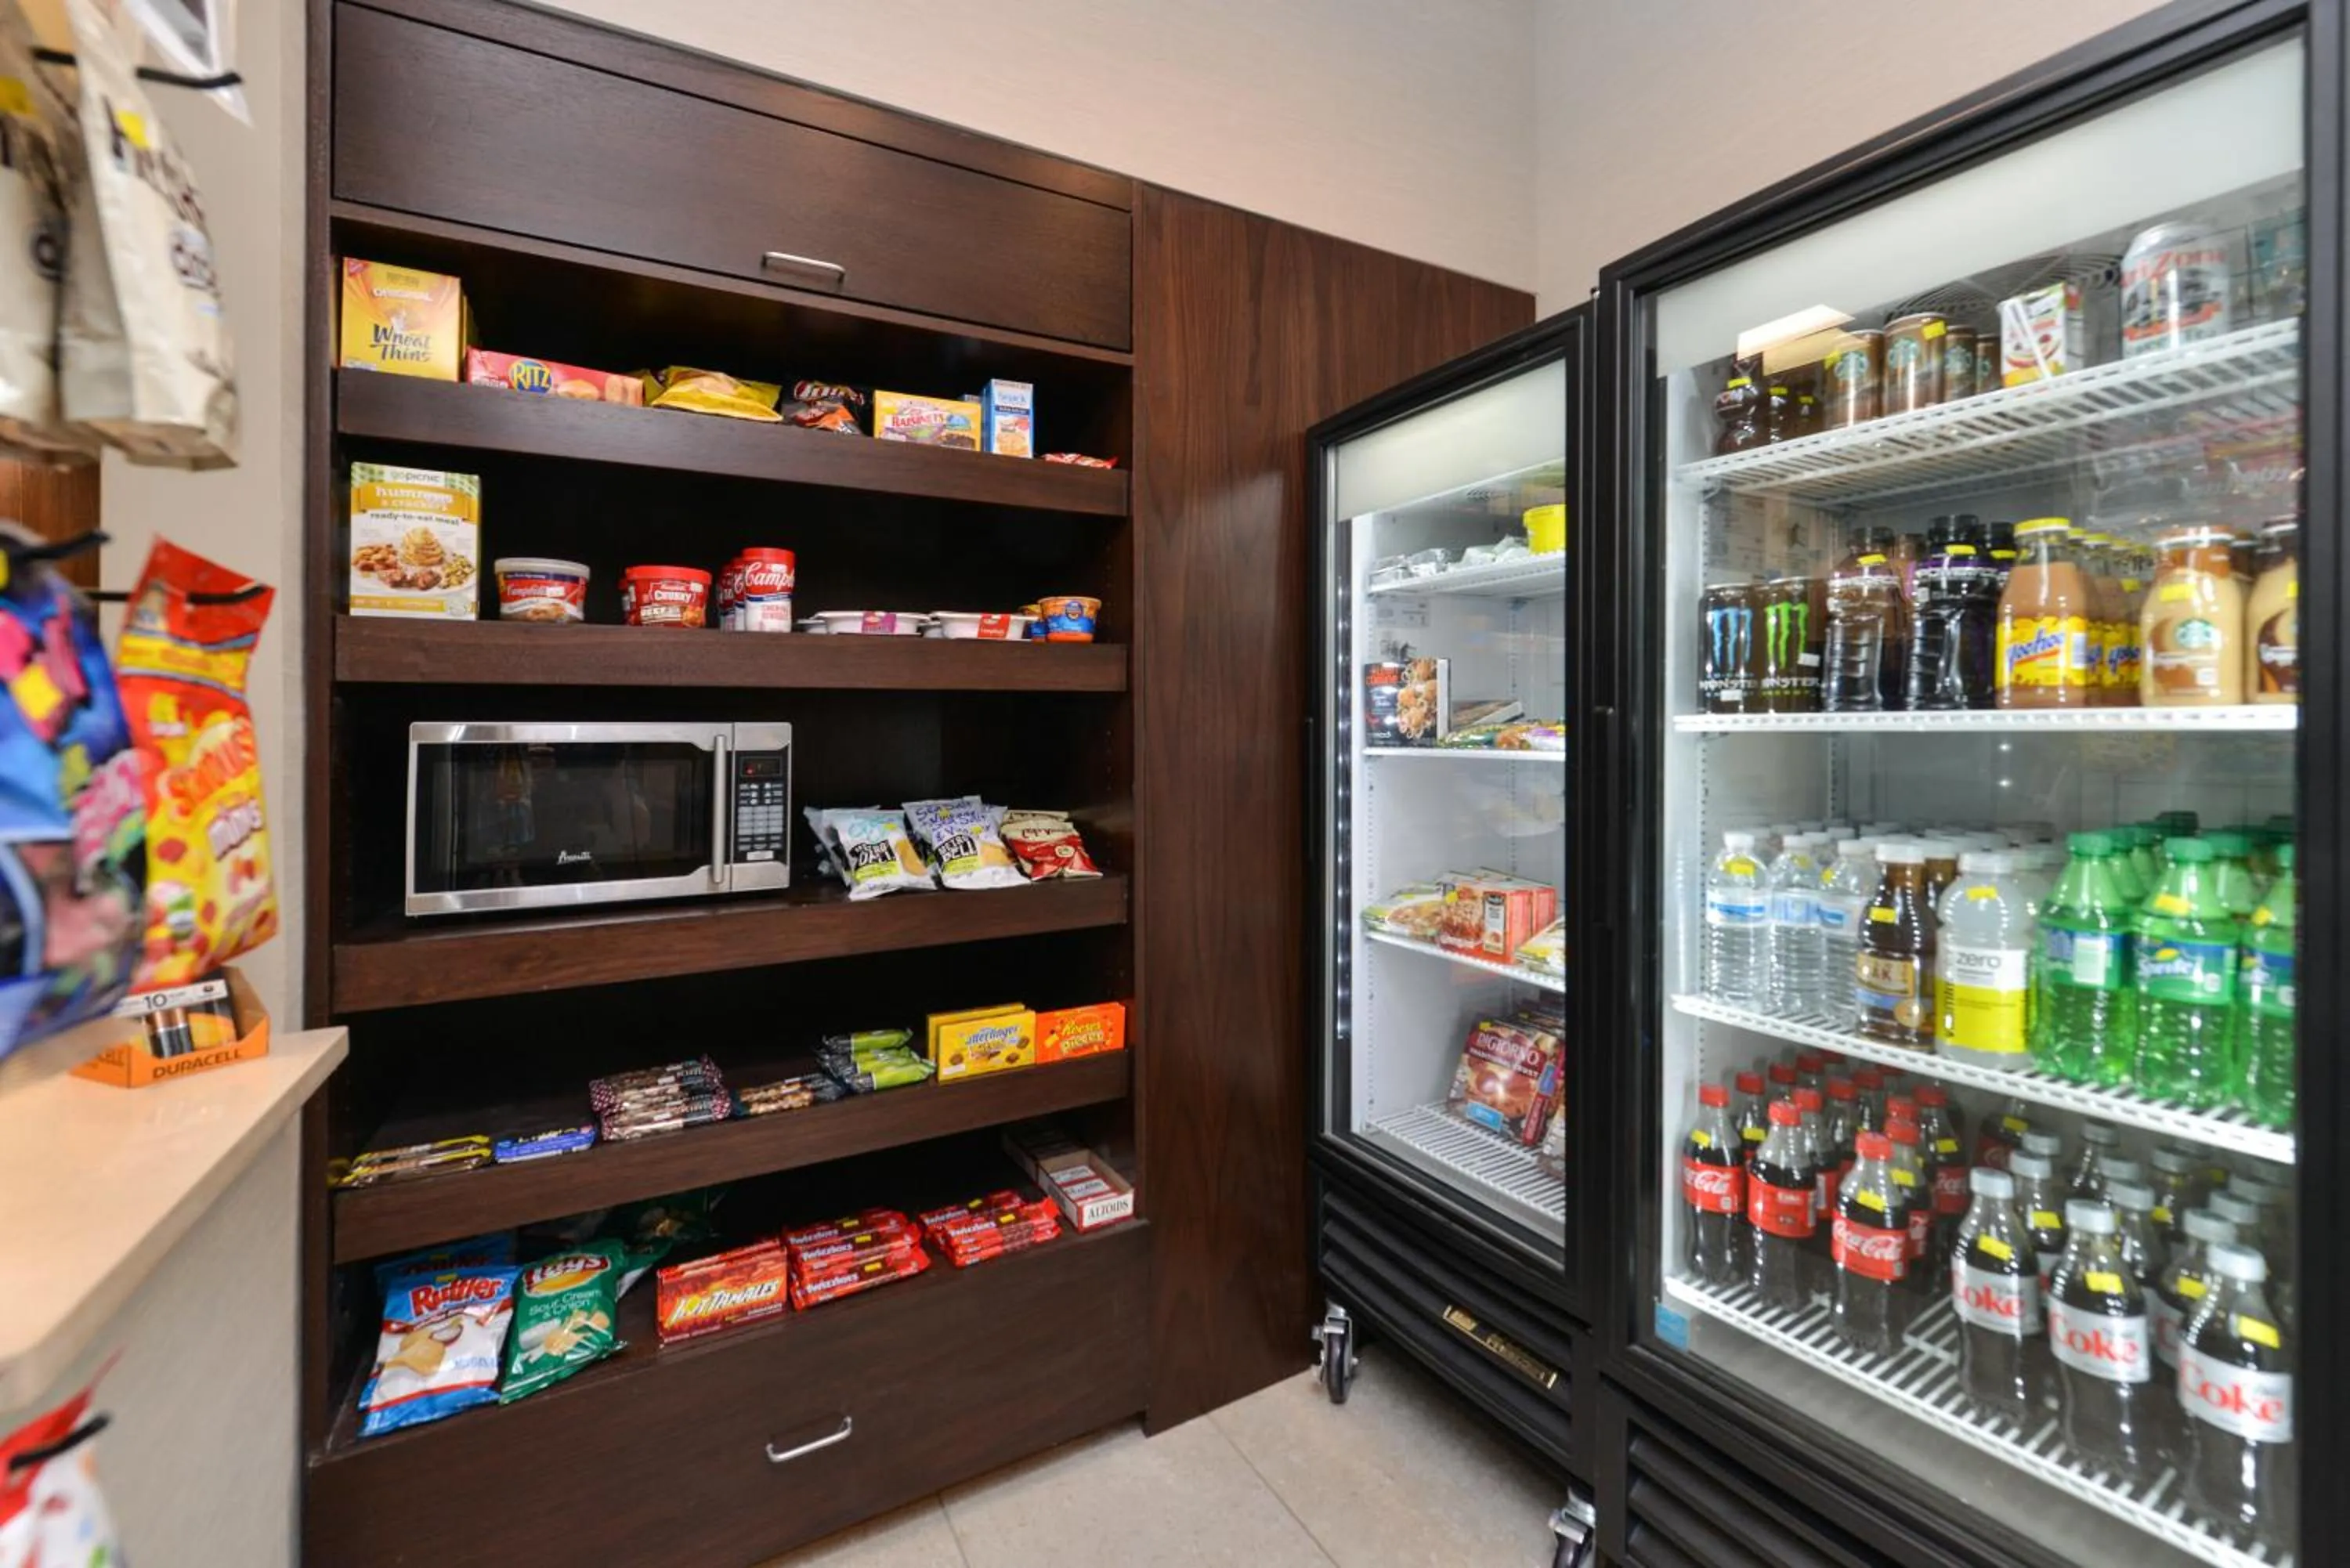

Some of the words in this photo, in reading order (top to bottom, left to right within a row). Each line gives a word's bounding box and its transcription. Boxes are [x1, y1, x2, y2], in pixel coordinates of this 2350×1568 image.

[372, 323, 432, 349] Wheat
[369, 343, 432, 363] Thins
[512, 363, 550, 389] RITZ
[1956, 952, 2001, 968] zero
[143, 992, 167, 1010] 10
[152, 1049, 240, 1079] DURACELL
[1088, 1198, 1129, 1219] ALTOIDS
[2051, 1306, 2139, 1364] Coke
[2181, 1357, 2284, 1423] Coke
